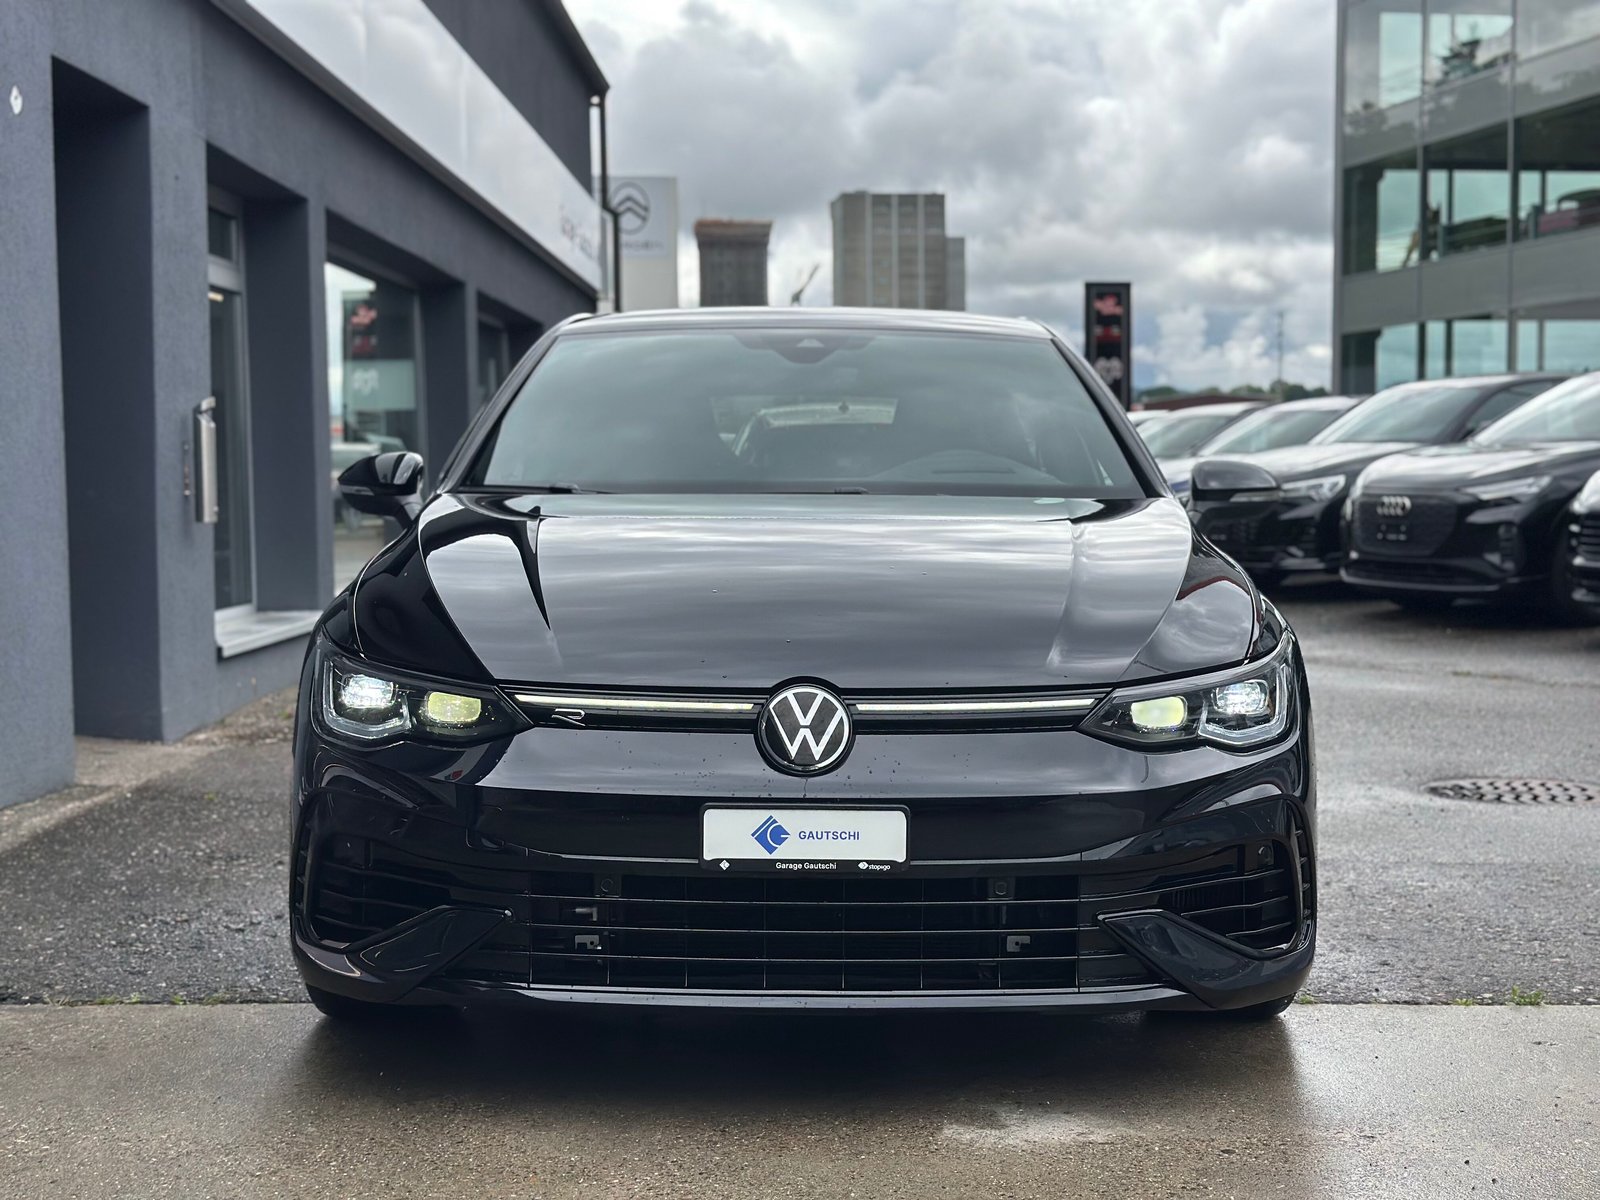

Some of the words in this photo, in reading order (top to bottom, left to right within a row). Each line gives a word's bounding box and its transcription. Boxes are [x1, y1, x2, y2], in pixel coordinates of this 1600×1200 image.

[767, 689, 848, 767] VW
[798, 830, 860, 841] GAUTSCHI
[775, 862, 803, 871] Garage
[803, 862, 837, 870] Gautschi
